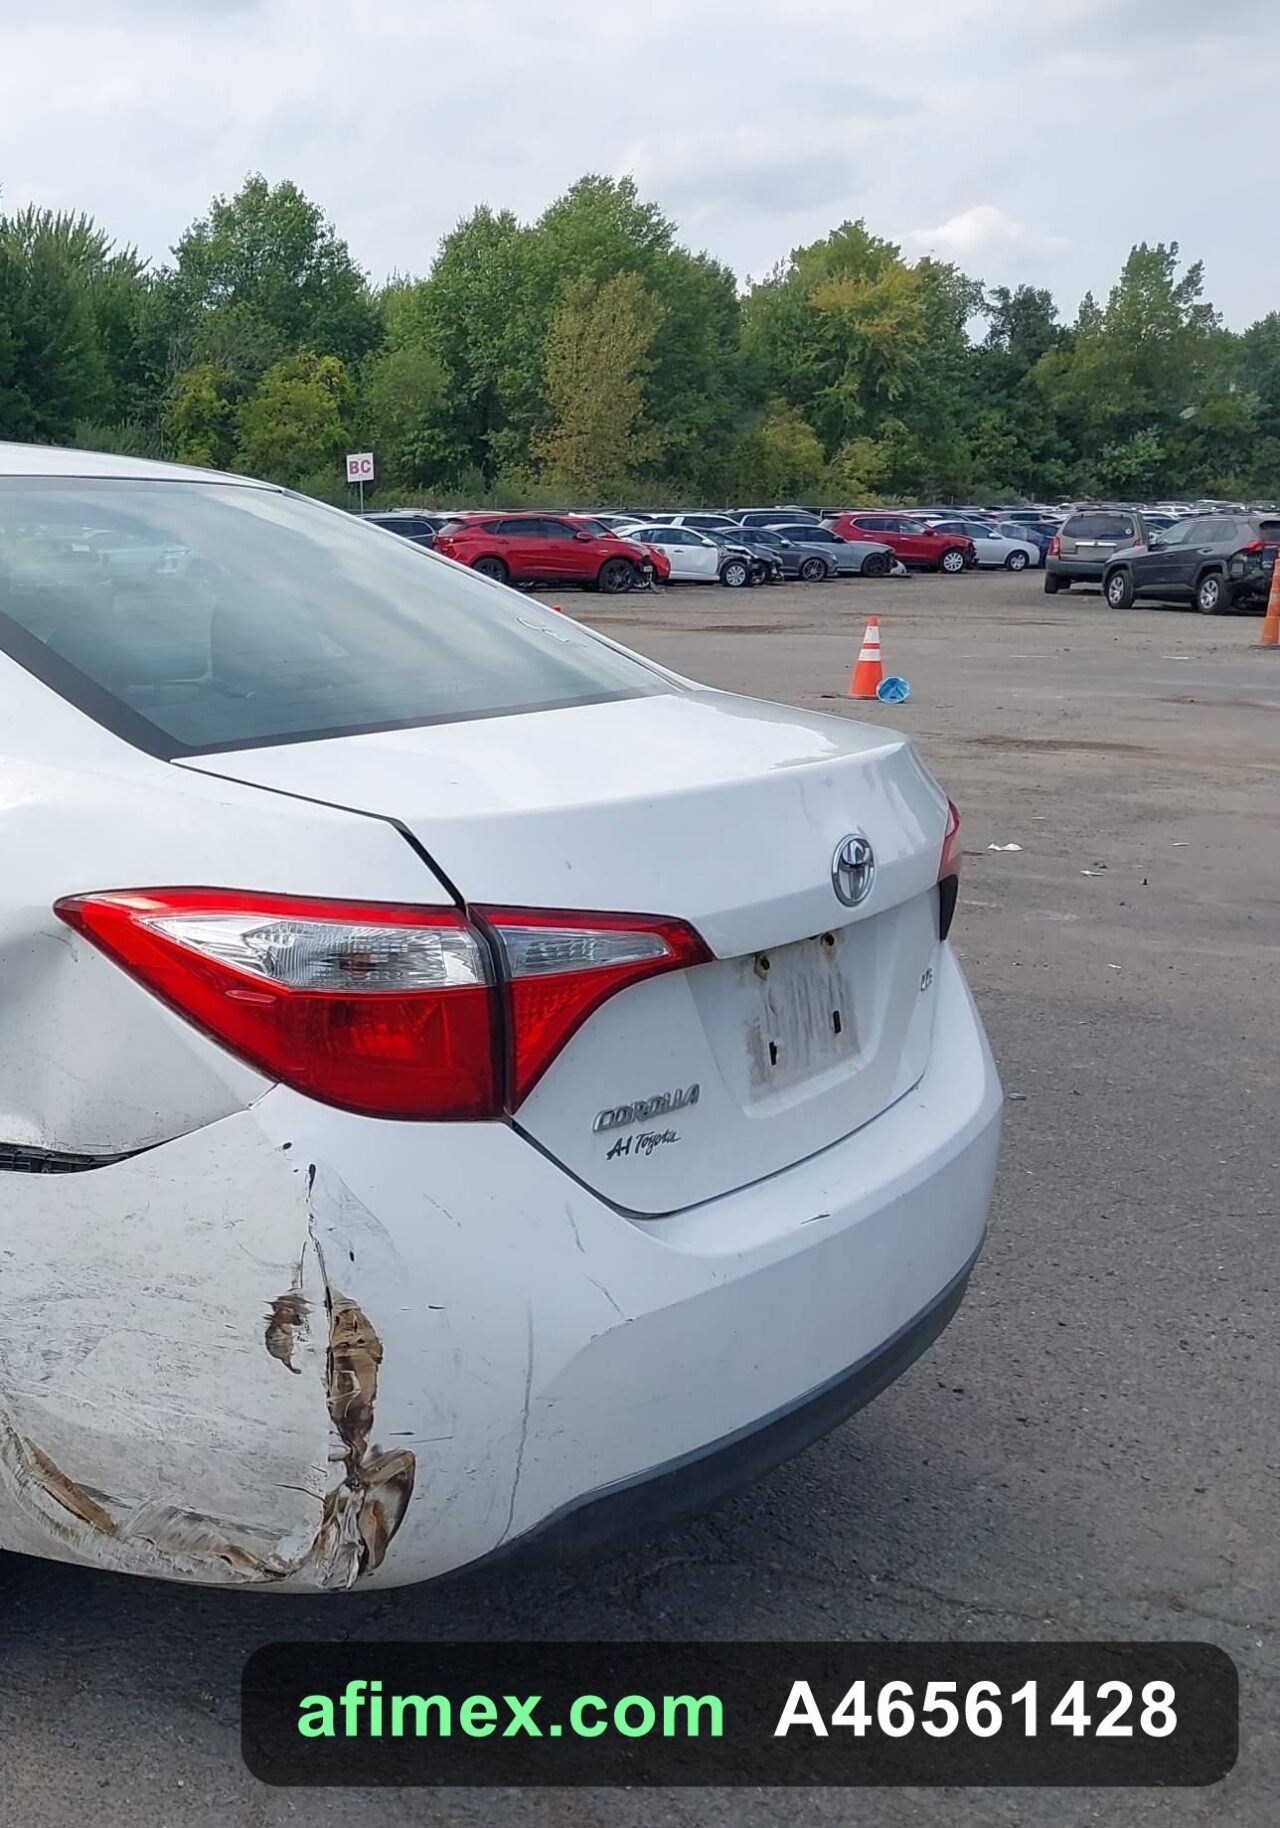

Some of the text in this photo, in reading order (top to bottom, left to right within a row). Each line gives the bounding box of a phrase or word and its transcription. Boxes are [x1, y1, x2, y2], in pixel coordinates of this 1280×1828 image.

[349, 460, 371, 475] BC
[592, 1084, 700, 1134] COROLLA
[634, 1129, 682, 1156] Toyota
